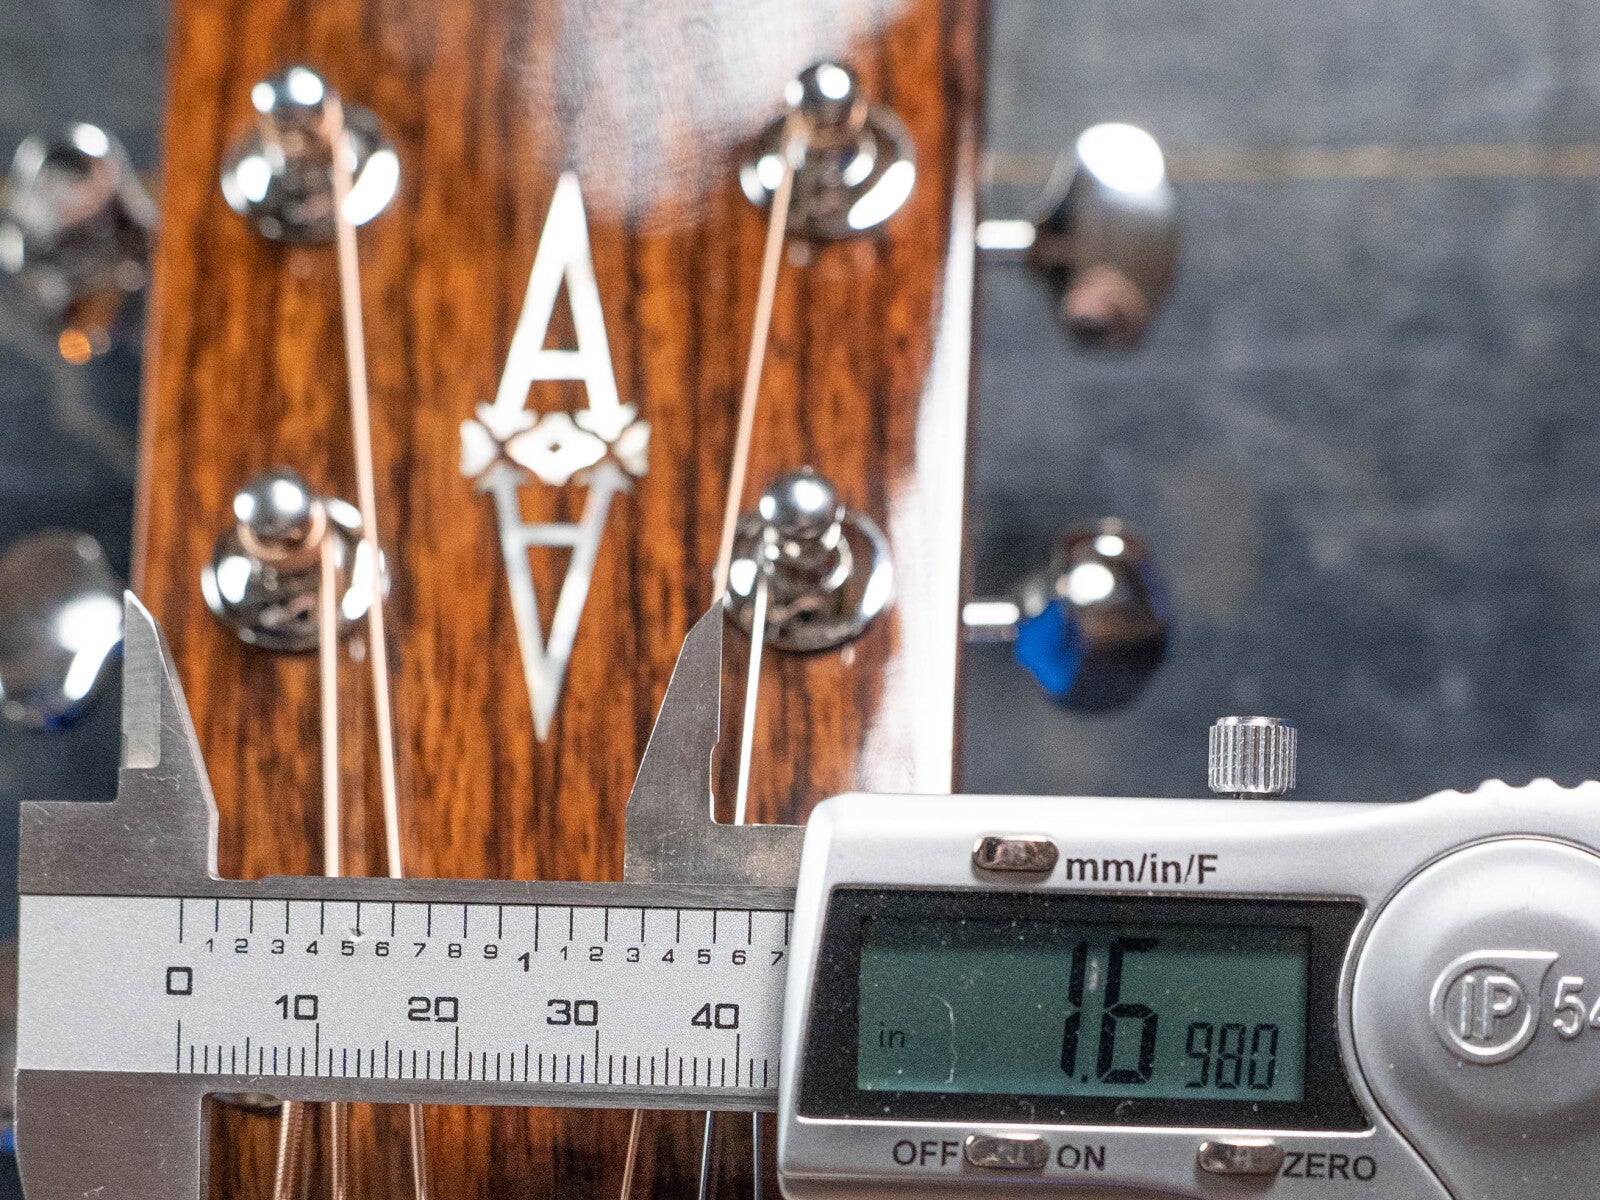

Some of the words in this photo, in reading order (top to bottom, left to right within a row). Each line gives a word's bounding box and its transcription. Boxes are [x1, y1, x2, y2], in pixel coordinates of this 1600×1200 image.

[1065, 853, 1218, 885] mm/in/F
[205, 939, 214, 952] 1
[235, 939, 248, 953] 2
[271, 939, 285, 954] 3
[306, 941, 319, 956] 4
[341, 941, 355, 956] 5
[375, 942, 389, 957] 6
[413, 943, 426, 957] 7
[448, 944, 462, 958] 8
[484, 944, 498, 959] 9
[518, 952, 530, 972] 1
[560, 946, 568, 961] 1
[589, 947, 604, 962] 2
[627, 948, 640, 963] 3
[662, 949, 675, 963] 4
[698, 950, 711, 964] 5
[732, 950, 746, 965] 6
[771, 951, 784, 966] 7
[166, 967, 193, 995] 0
[275, 994, 318, 1020] 10
[408, 997, 458, 1022] 20
[547, 999, 598, 1026] 30
[691, 1003, 739, 1030] 40
[1461, 974, 1521, 1040] IP
[878, 1022, 905, 1049] in
[893, 1140, 959, 1166] OFF
[1057, 1145, 1106, 1170] ON
[1282, 1152, 1377, 1180] ZERO
